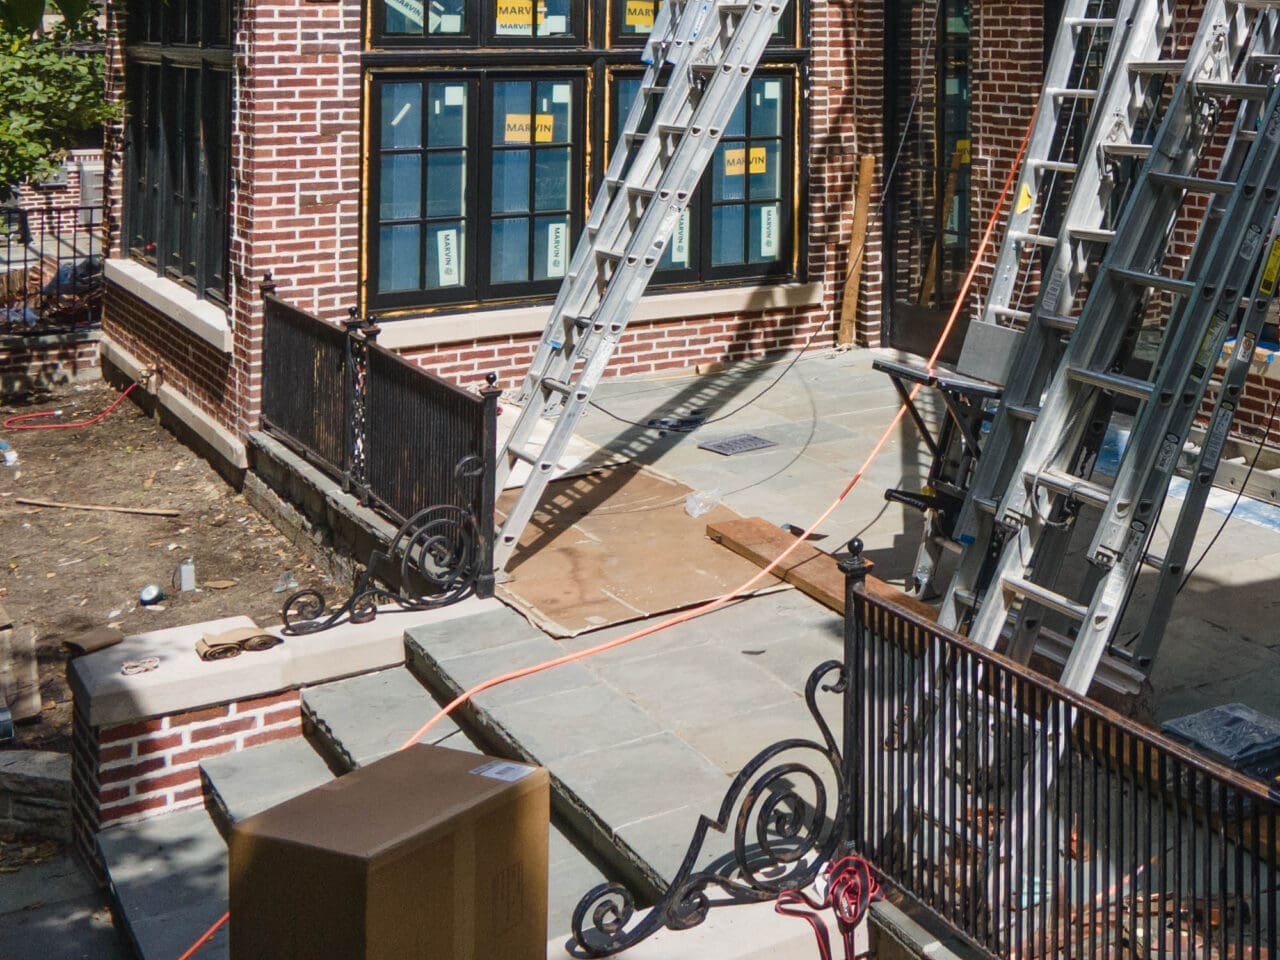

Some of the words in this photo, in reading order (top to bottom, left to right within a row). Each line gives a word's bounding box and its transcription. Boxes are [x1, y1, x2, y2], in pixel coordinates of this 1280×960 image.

[499, 6, 532, 15] MARV
[628, 8, 654, 16] MAR
[506, 122, 551, 133] MARVIN
[553, 227, 561, 259] MARVIN
